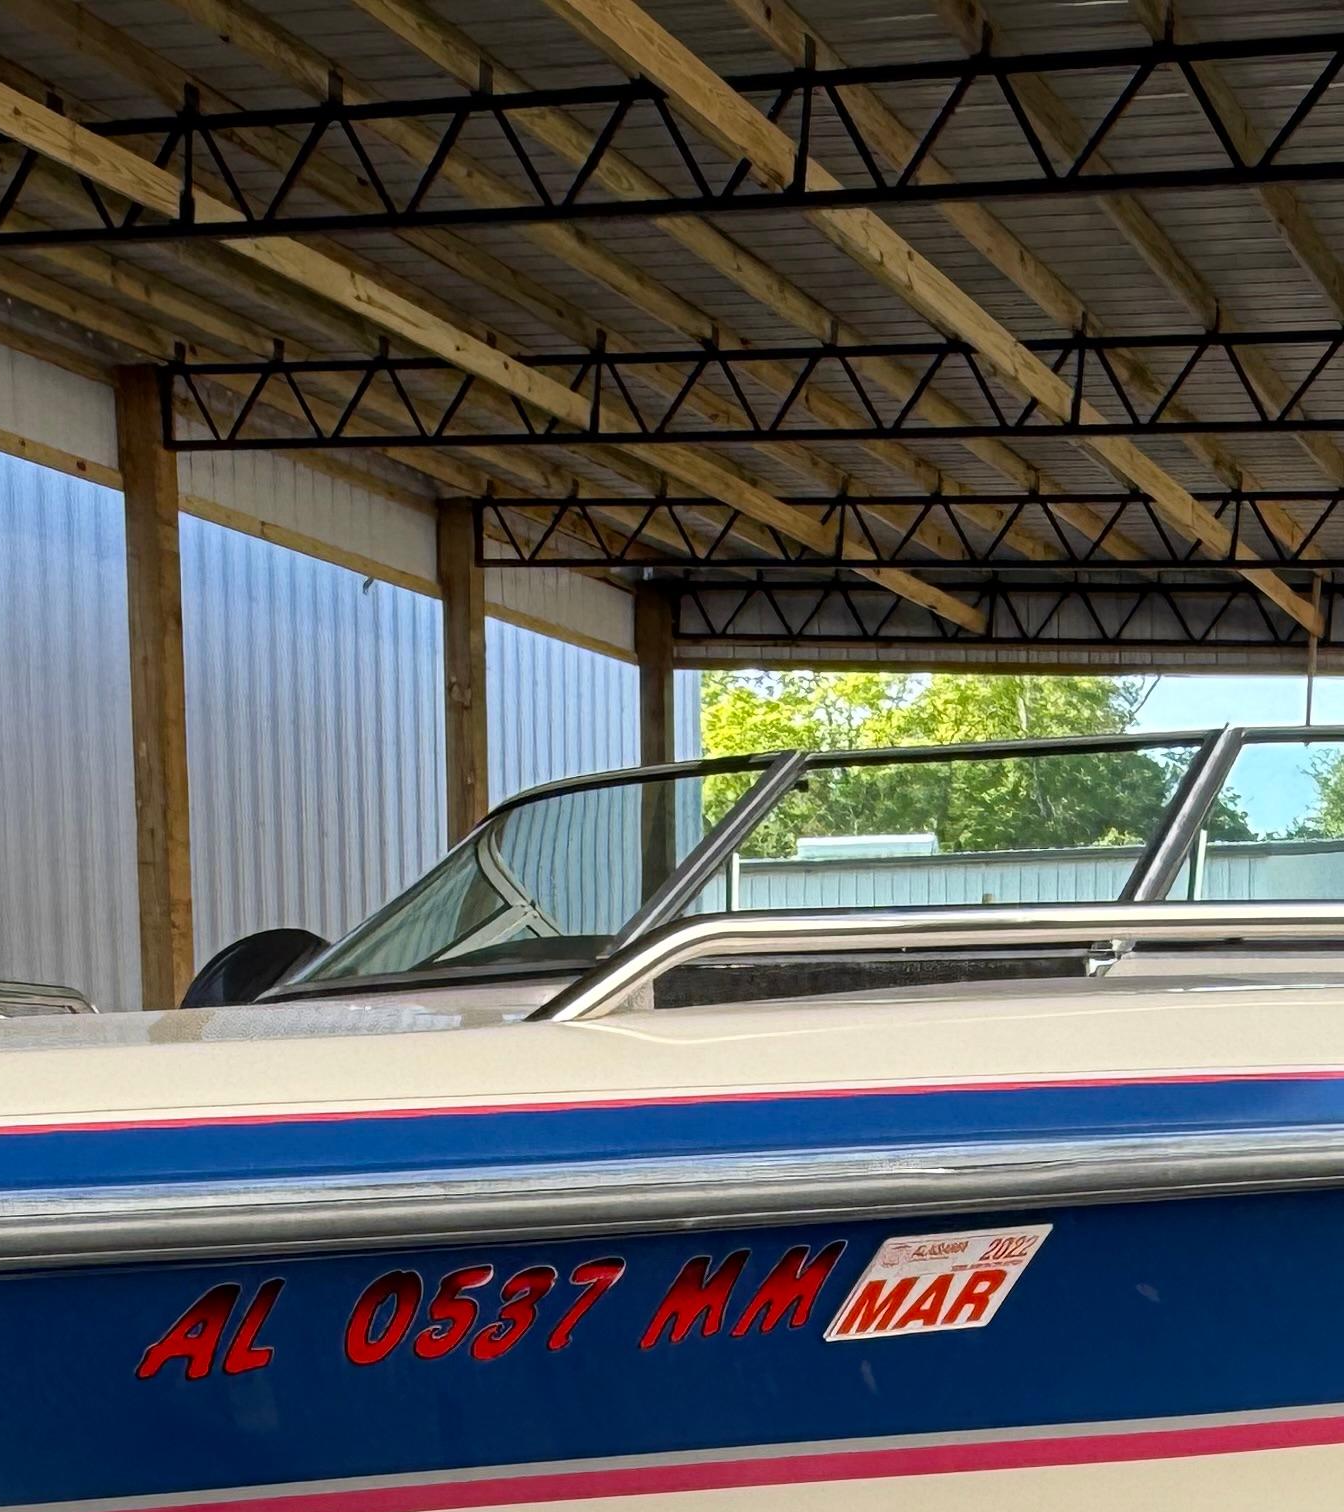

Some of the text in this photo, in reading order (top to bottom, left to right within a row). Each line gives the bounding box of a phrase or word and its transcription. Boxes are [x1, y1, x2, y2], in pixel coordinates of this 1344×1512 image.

[979, 1235, 1040, 1262] 2022
[135, 1239, 849, 1382] AL 0537 MM
[836, 1269, 1008, 1336] MAR
